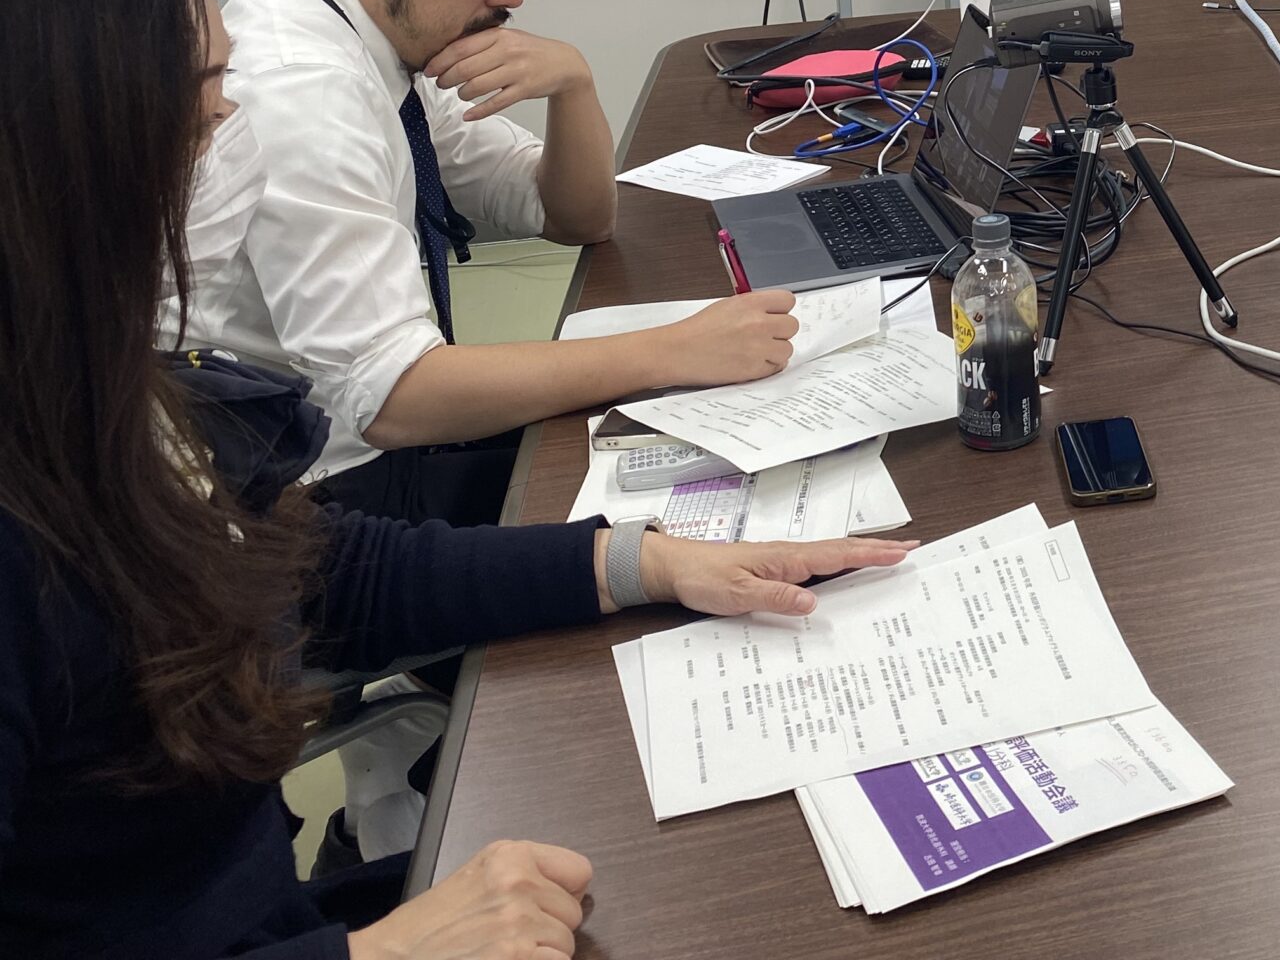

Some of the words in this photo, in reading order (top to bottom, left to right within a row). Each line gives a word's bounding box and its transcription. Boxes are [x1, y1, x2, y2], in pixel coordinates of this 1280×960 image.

[1074, 49, 1103, 57] SONY
[1003, 735, 1081, 814] 評価活動会議
